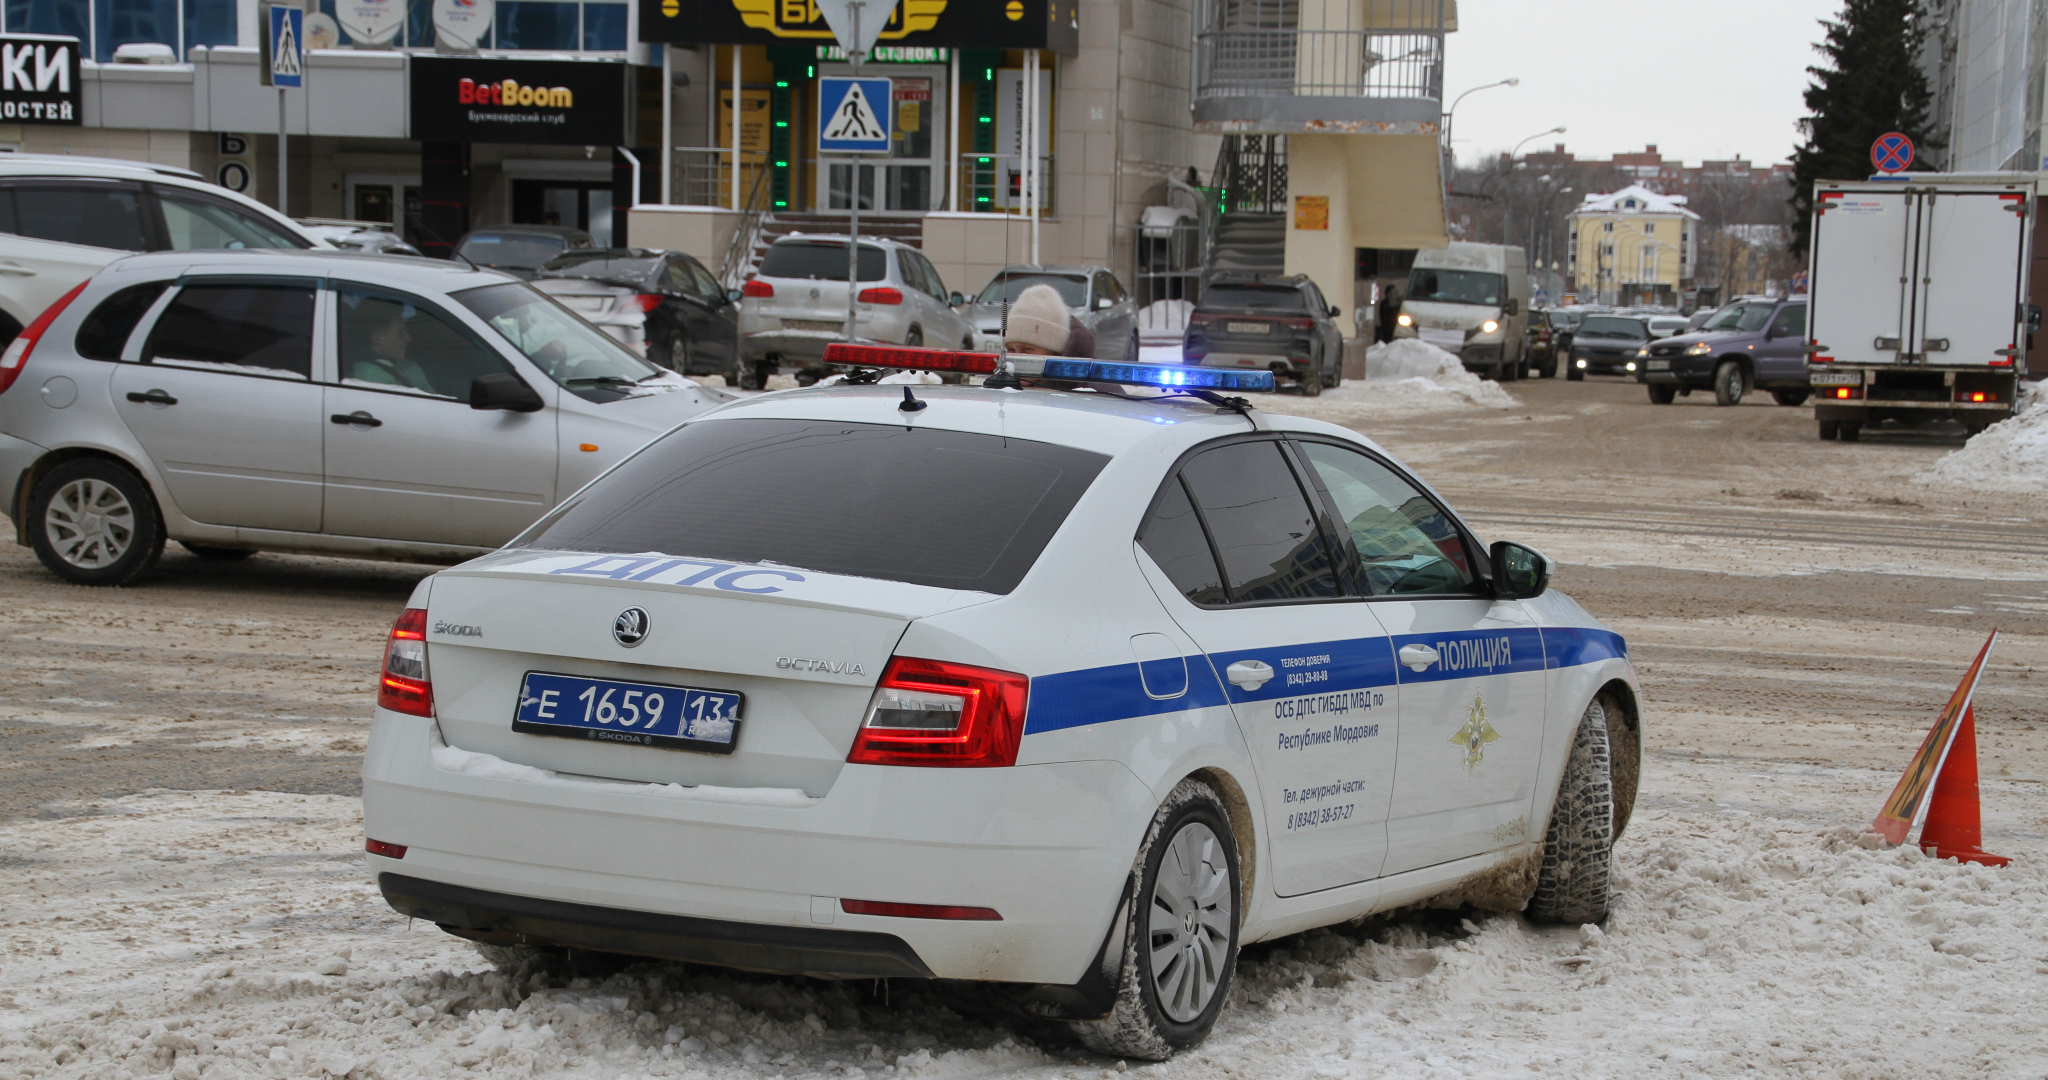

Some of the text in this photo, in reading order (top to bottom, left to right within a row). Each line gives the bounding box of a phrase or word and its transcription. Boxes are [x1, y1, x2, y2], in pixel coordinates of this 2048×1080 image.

[2, 42, 71, 93] КИ
[459, 77, 573, 108] BetBoom
[550, 555, 806, 594] ДПС
[433, 620, 483, 638] ŠKODA
[776, 656, 866, 676] OCTAVIA
[1281, 654, 1331, 668] ТЕЛЕФОН ДОВЕРИЯ
[1436, 636, 1511, 673] ПОЛИЦИЯ
[1286, 672, 1305, 687] (8342)
[578, 685, 665, 729] 1659
[690, 695, 725, 723] 13
[1275, 690, 1384, 720] ОСБ ДПС ГИБДД МВД по
[598, 732, 641, 743] ŠKODA
[1278, 723, 1379, 751] Республике Мордовия
[1283, 778, 1366, 804] Тел. дежурной части:
[1287, 803, 1355, 832] 8 (8342) 38-57-27
